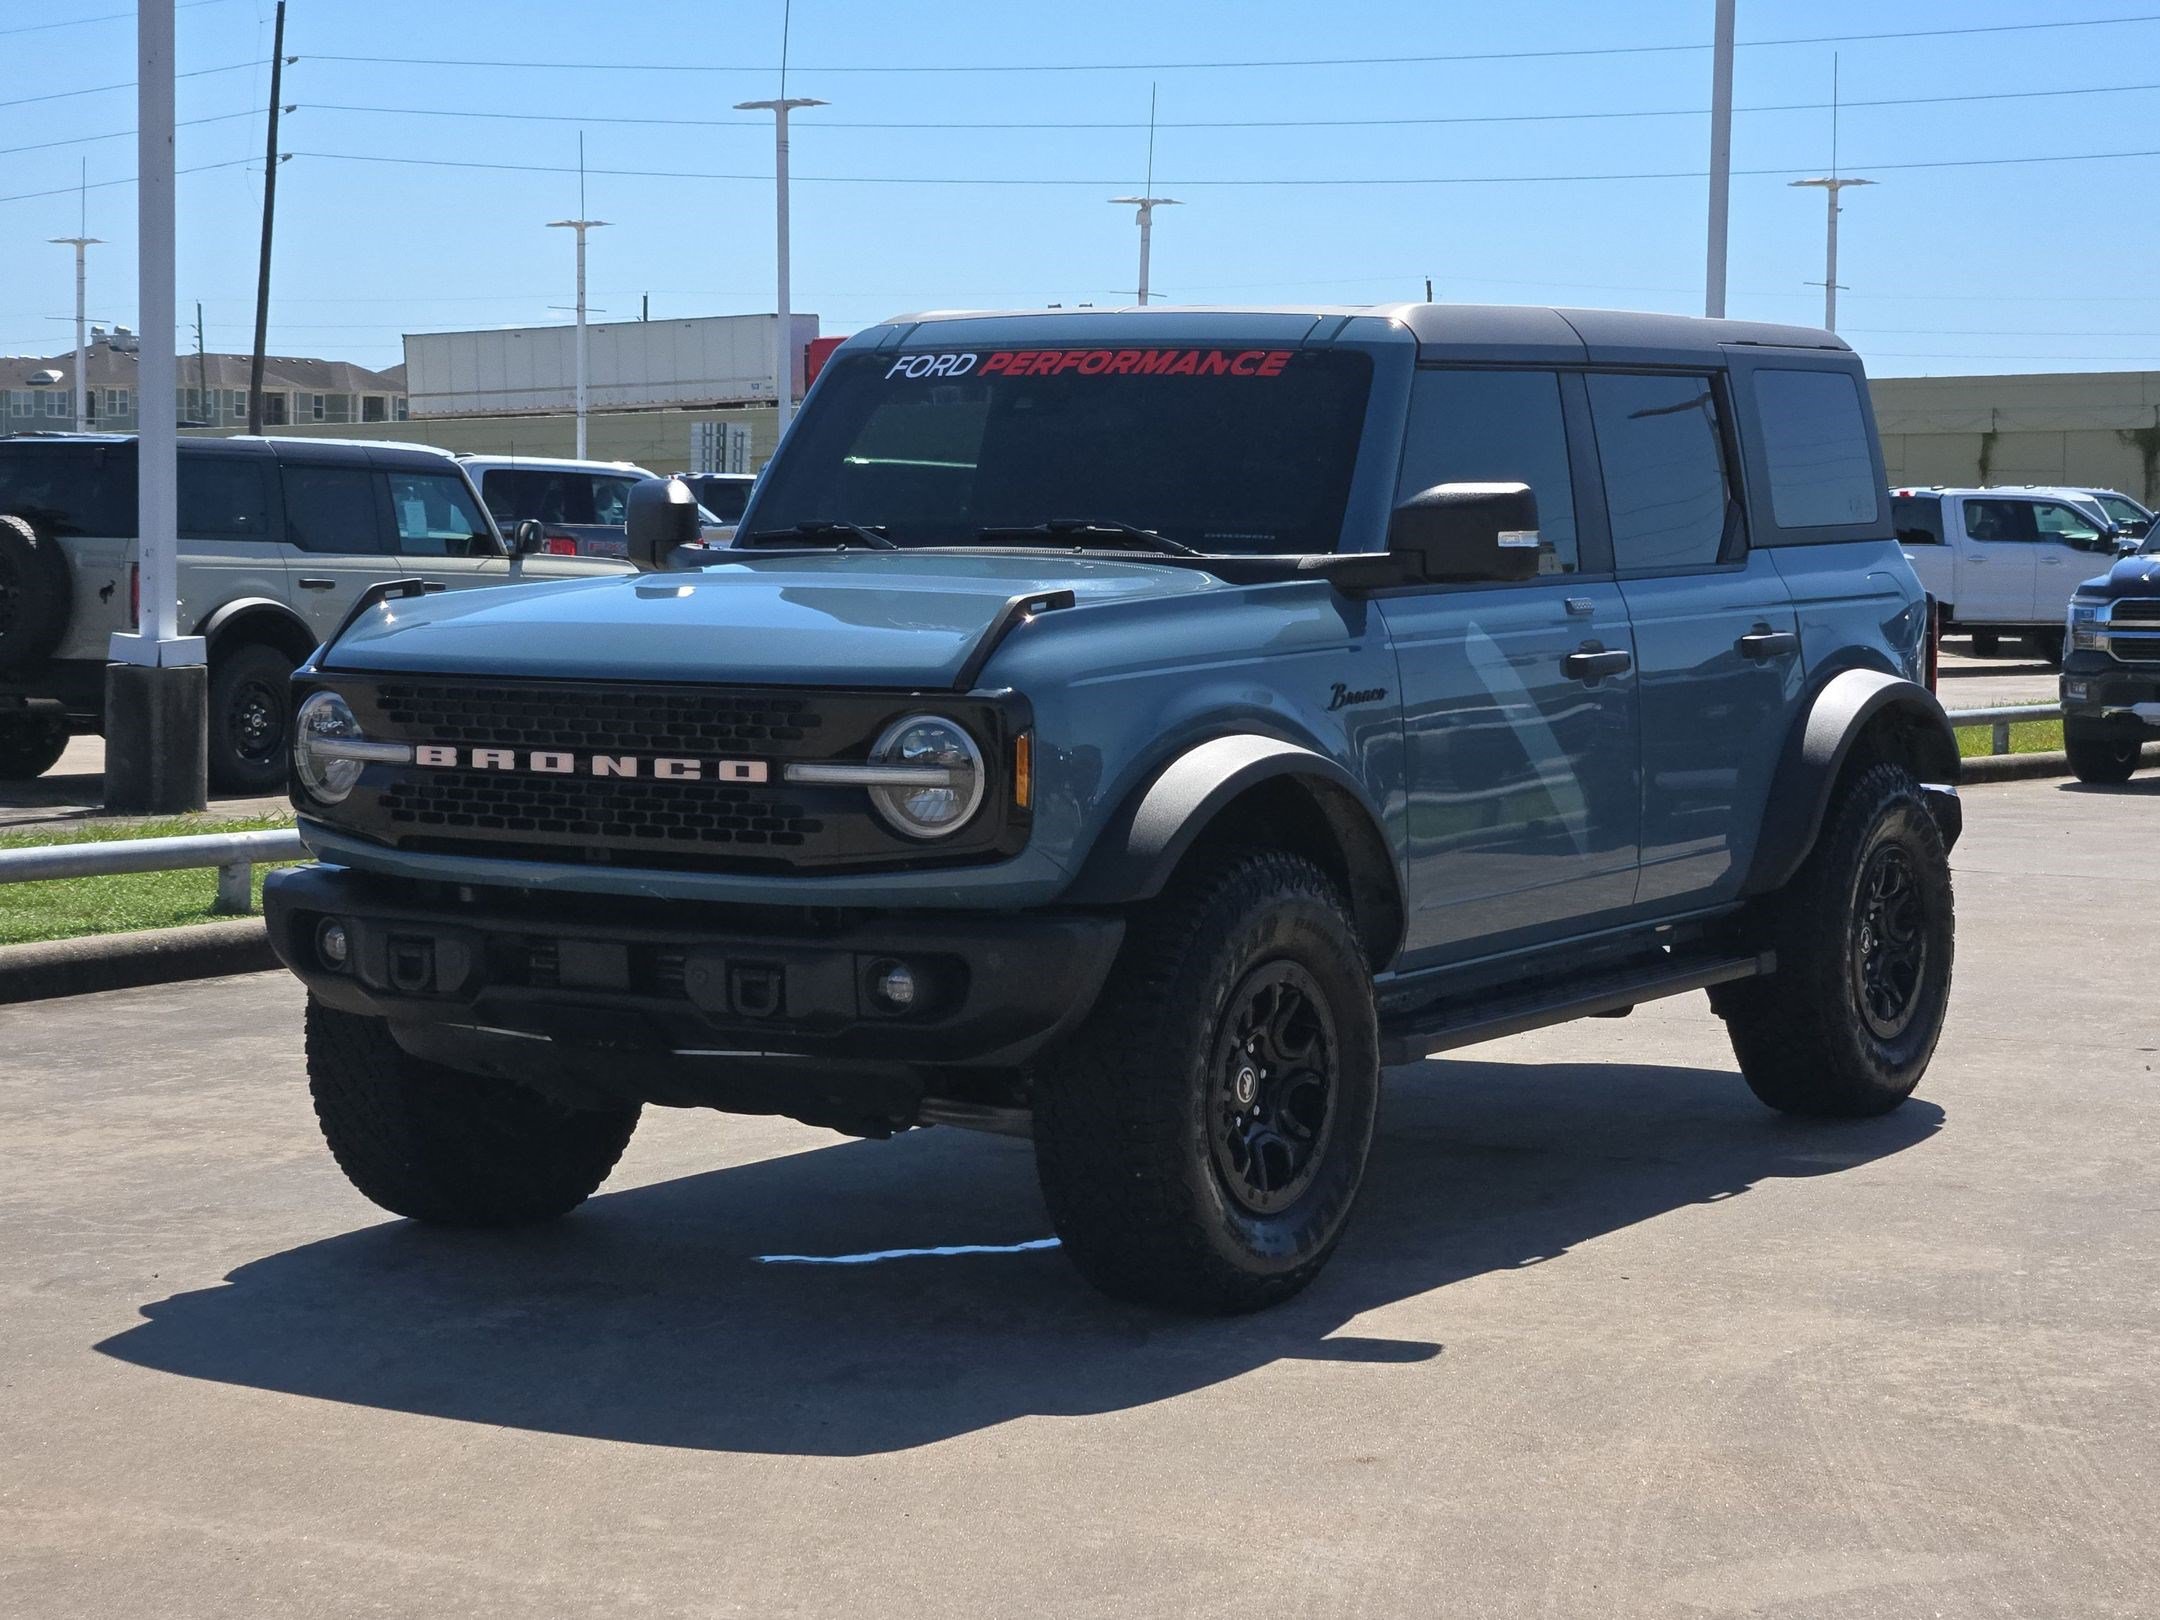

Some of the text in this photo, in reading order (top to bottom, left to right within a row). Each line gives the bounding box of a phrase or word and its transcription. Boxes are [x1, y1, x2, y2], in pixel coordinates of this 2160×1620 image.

[884, 350, 1294, 380] FORD PERFORMANCE
[416, 745, 768, 783] BRONCO
